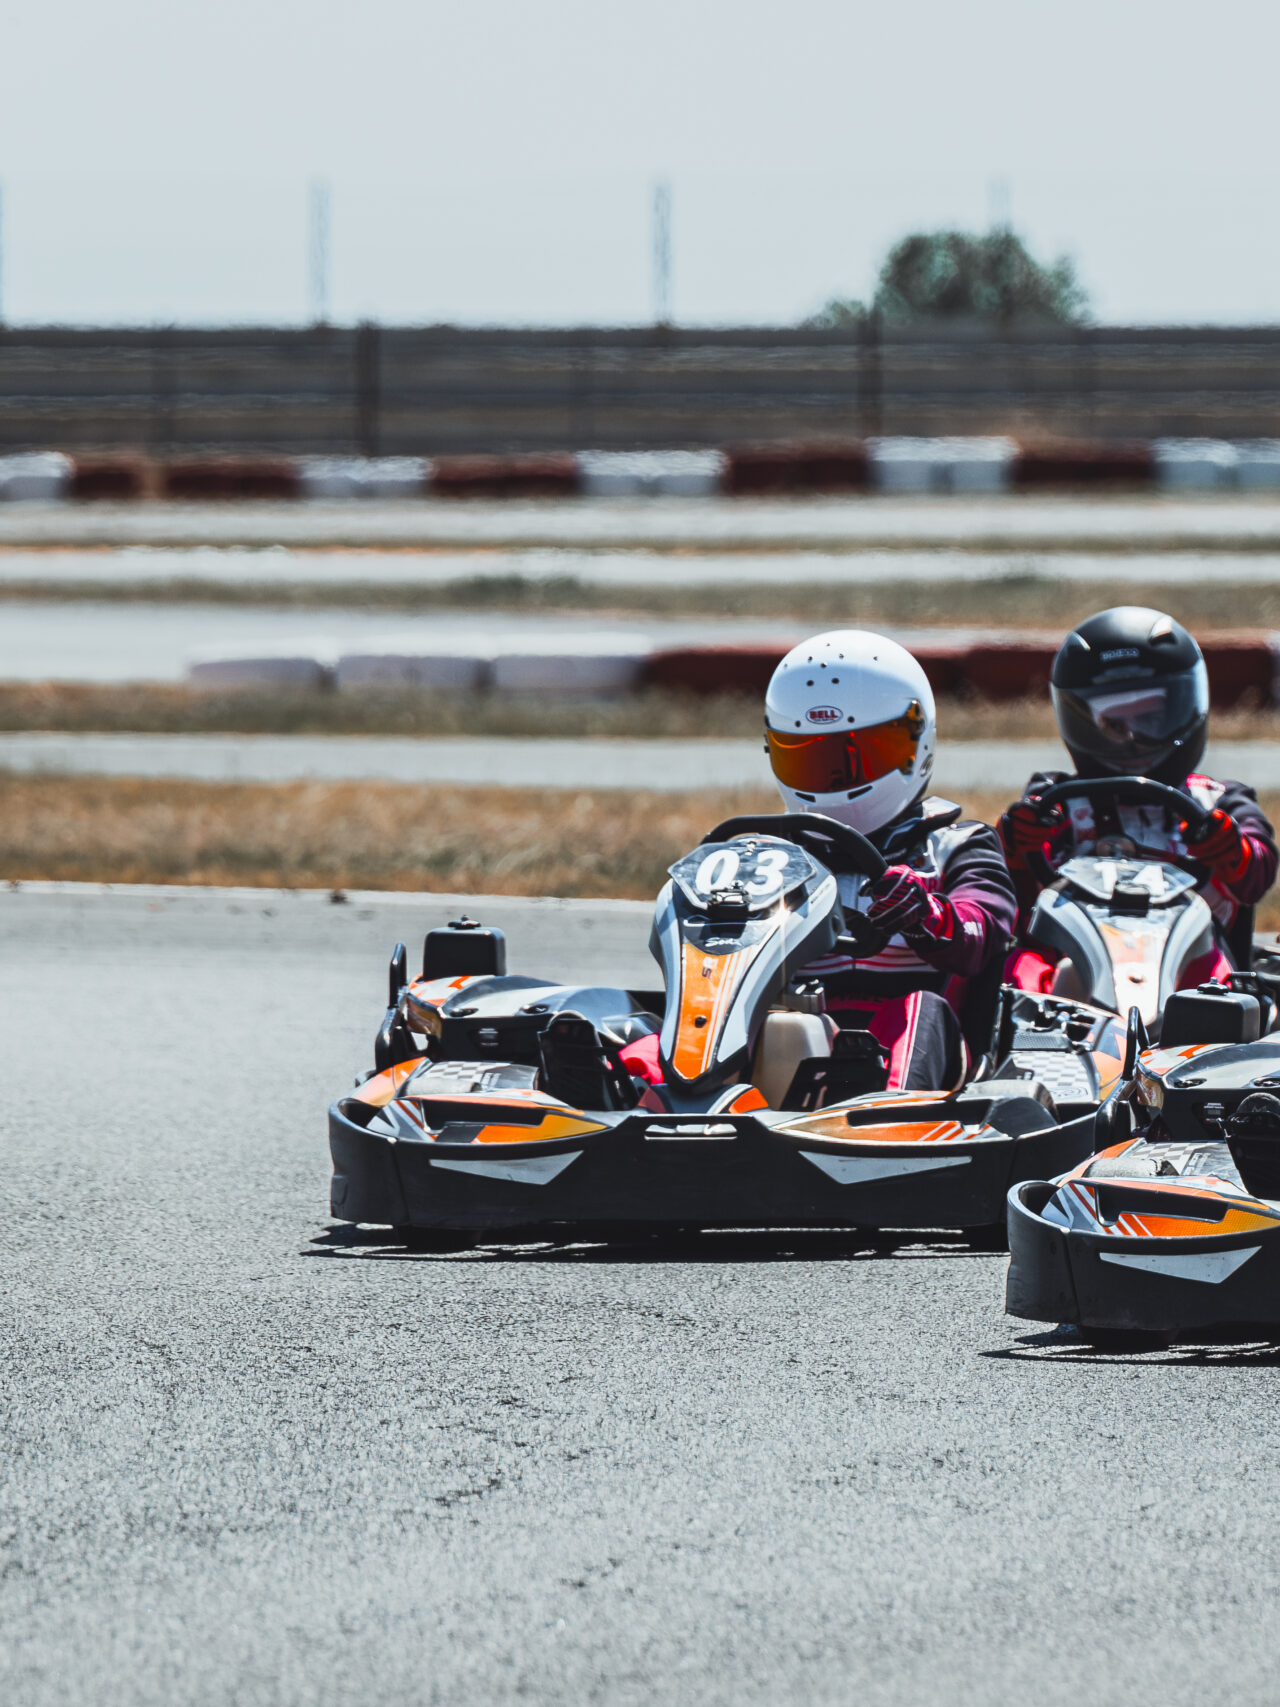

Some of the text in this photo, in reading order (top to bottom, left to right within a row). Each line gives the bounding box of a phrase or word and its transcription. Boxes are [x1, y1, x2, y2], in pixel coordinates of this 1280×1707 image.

[809, 710, 839, 720] BELL
[695, 849, 790, 897] 03
[1093, 861, 1170, 898] 14
